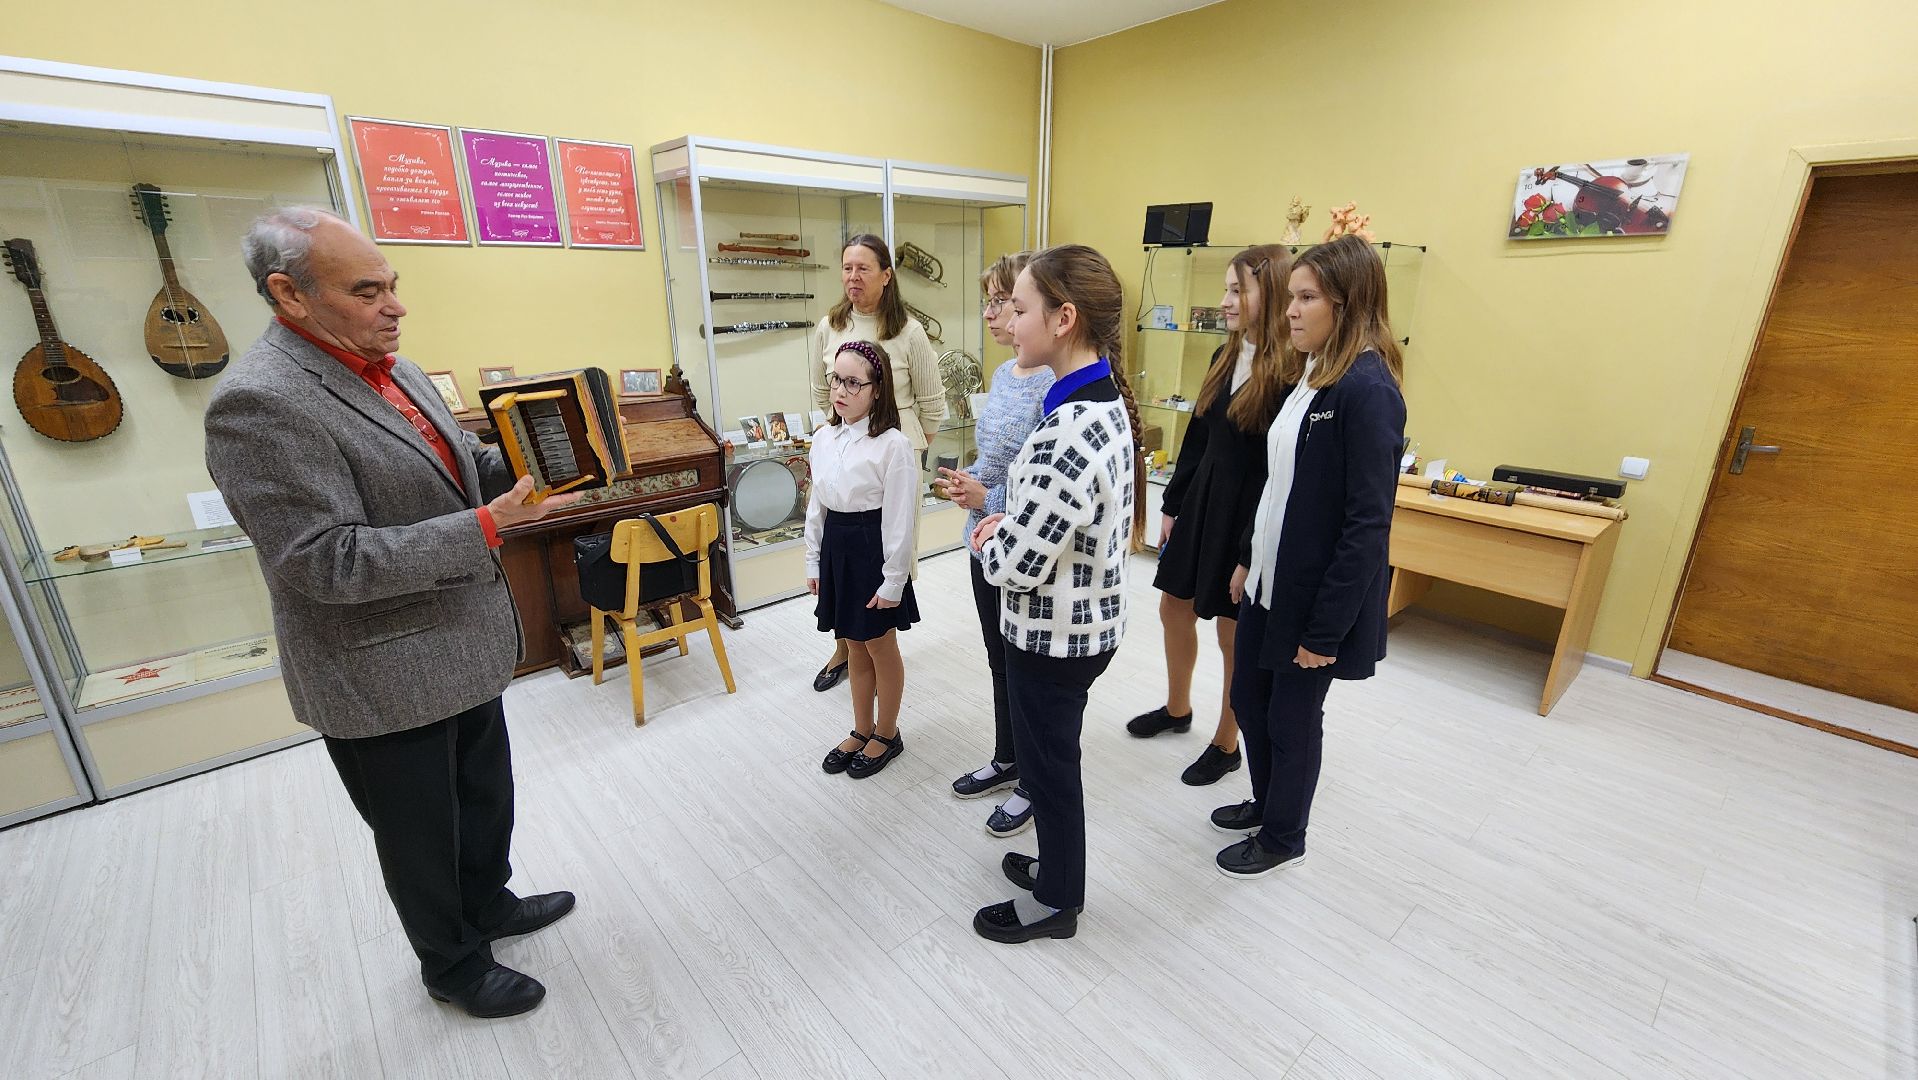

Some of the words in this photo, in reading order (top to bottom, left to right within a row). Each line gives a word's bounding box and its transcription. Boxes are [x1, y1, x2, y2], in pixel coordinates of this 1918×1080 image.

[389, 154, 426, 164] Музыка,
[480, 157, 511, 168] Музыка
[384, 165, 408, 173] подобно
